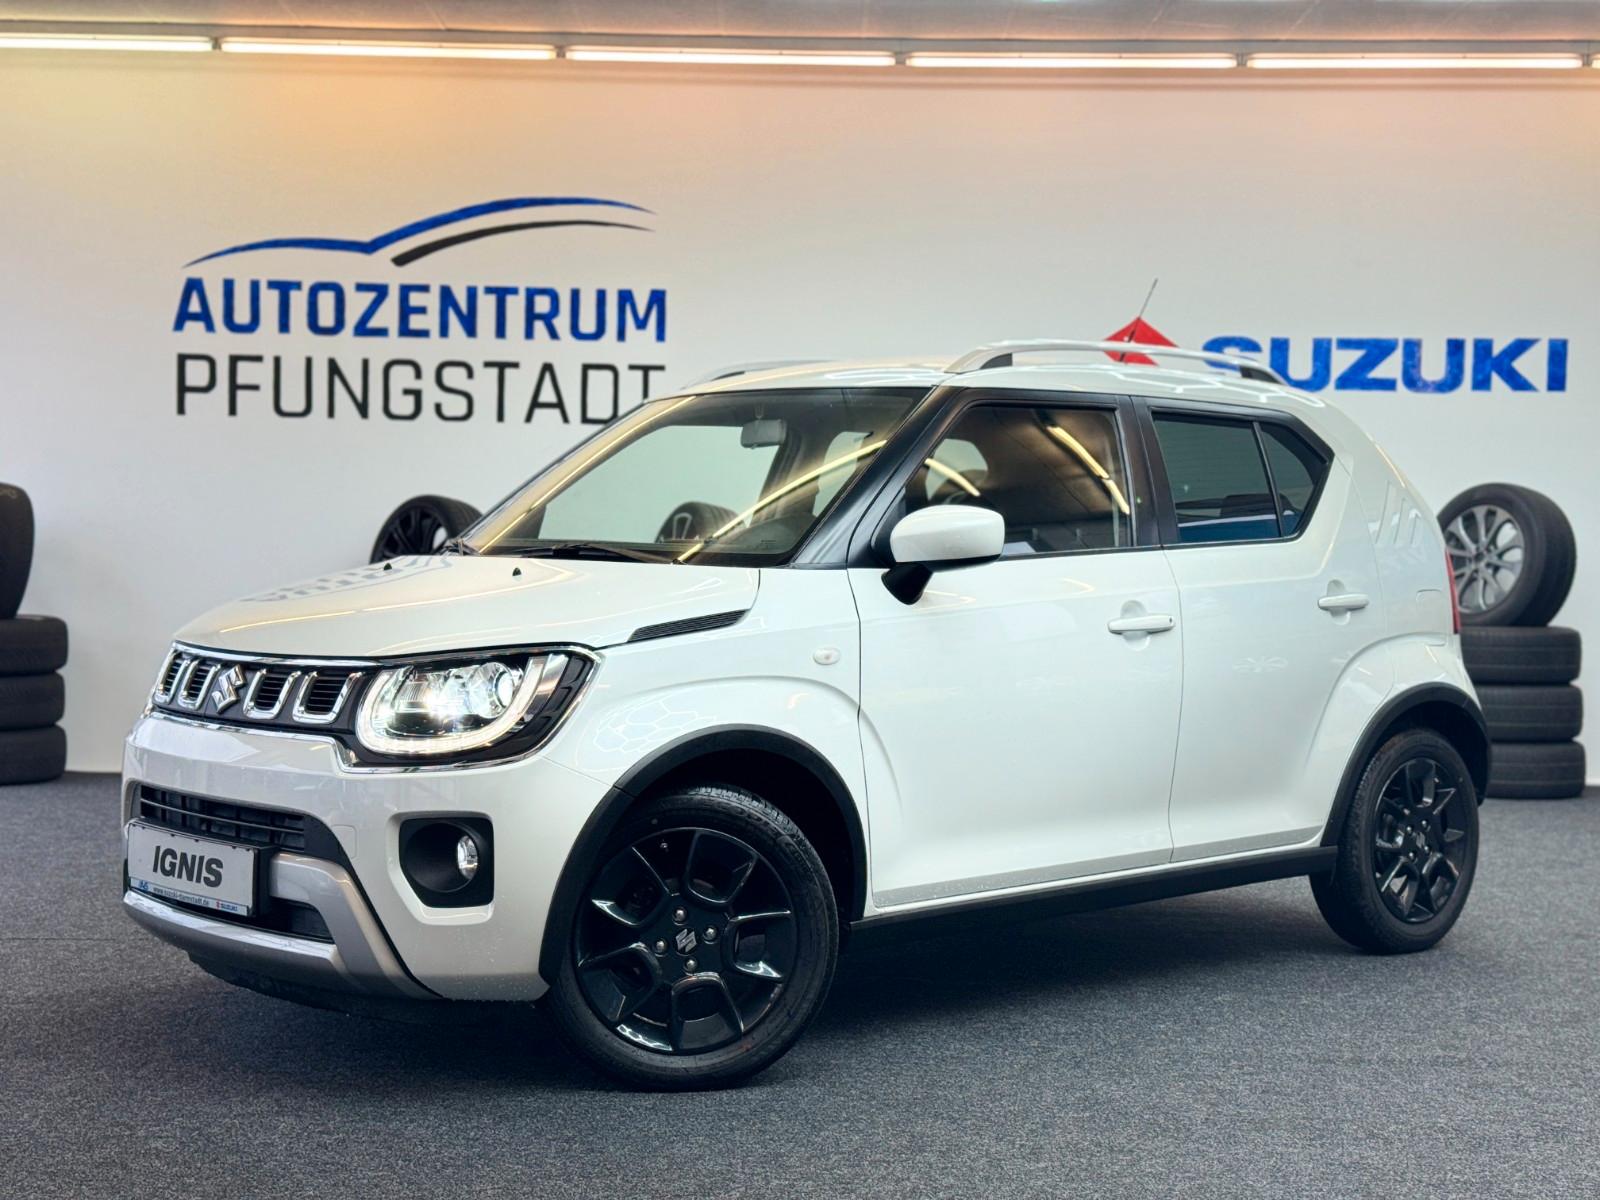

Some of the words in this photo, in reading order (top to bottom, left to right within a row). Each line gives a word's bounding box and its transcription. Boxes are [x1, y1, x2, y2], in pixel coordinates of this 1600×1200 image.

[173, 278, 666, 342] AUTOZENTRUM
[176, 353, 665, 424] PFUNGSTADT
[152, 845, 224, 888] IGNIS
